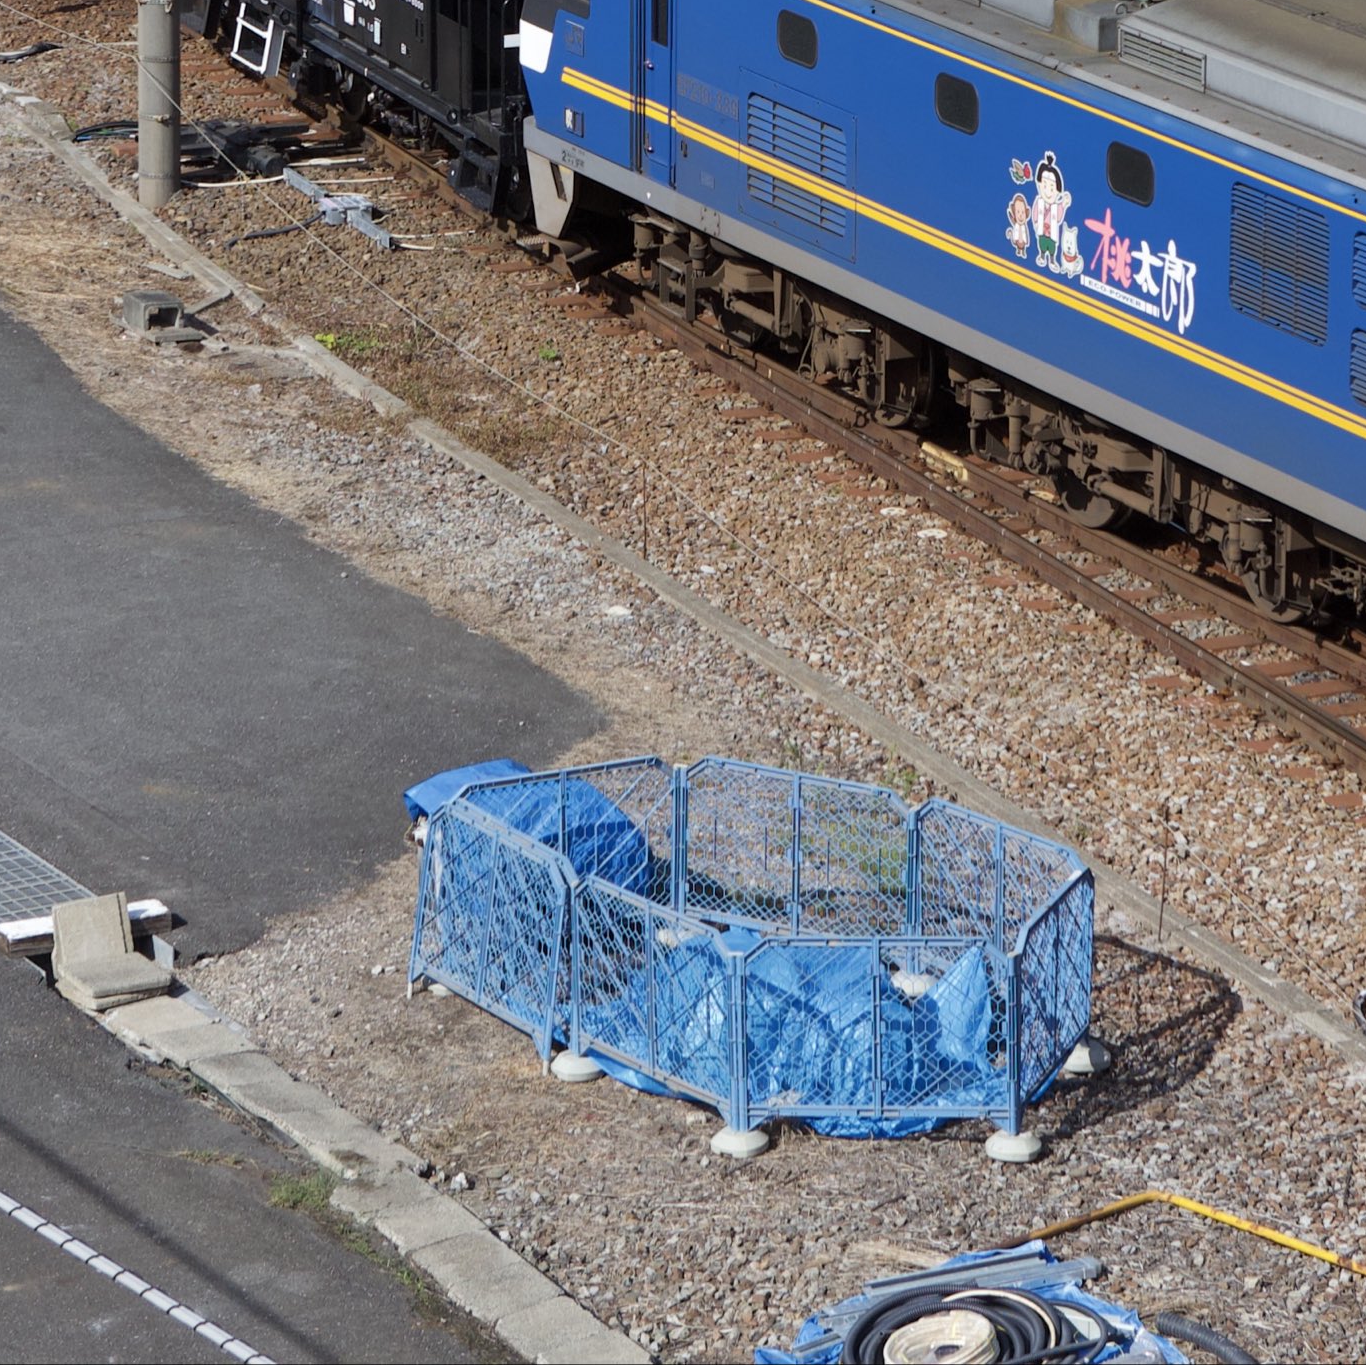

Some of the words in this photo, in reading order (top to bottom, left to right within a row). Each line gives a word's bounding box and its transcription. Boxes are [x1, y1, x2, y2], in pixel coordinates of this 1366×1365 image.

[1084, 207, 1196, 334] 桃太郎
[1088, 278, 1143, 308] ECO-POWER
